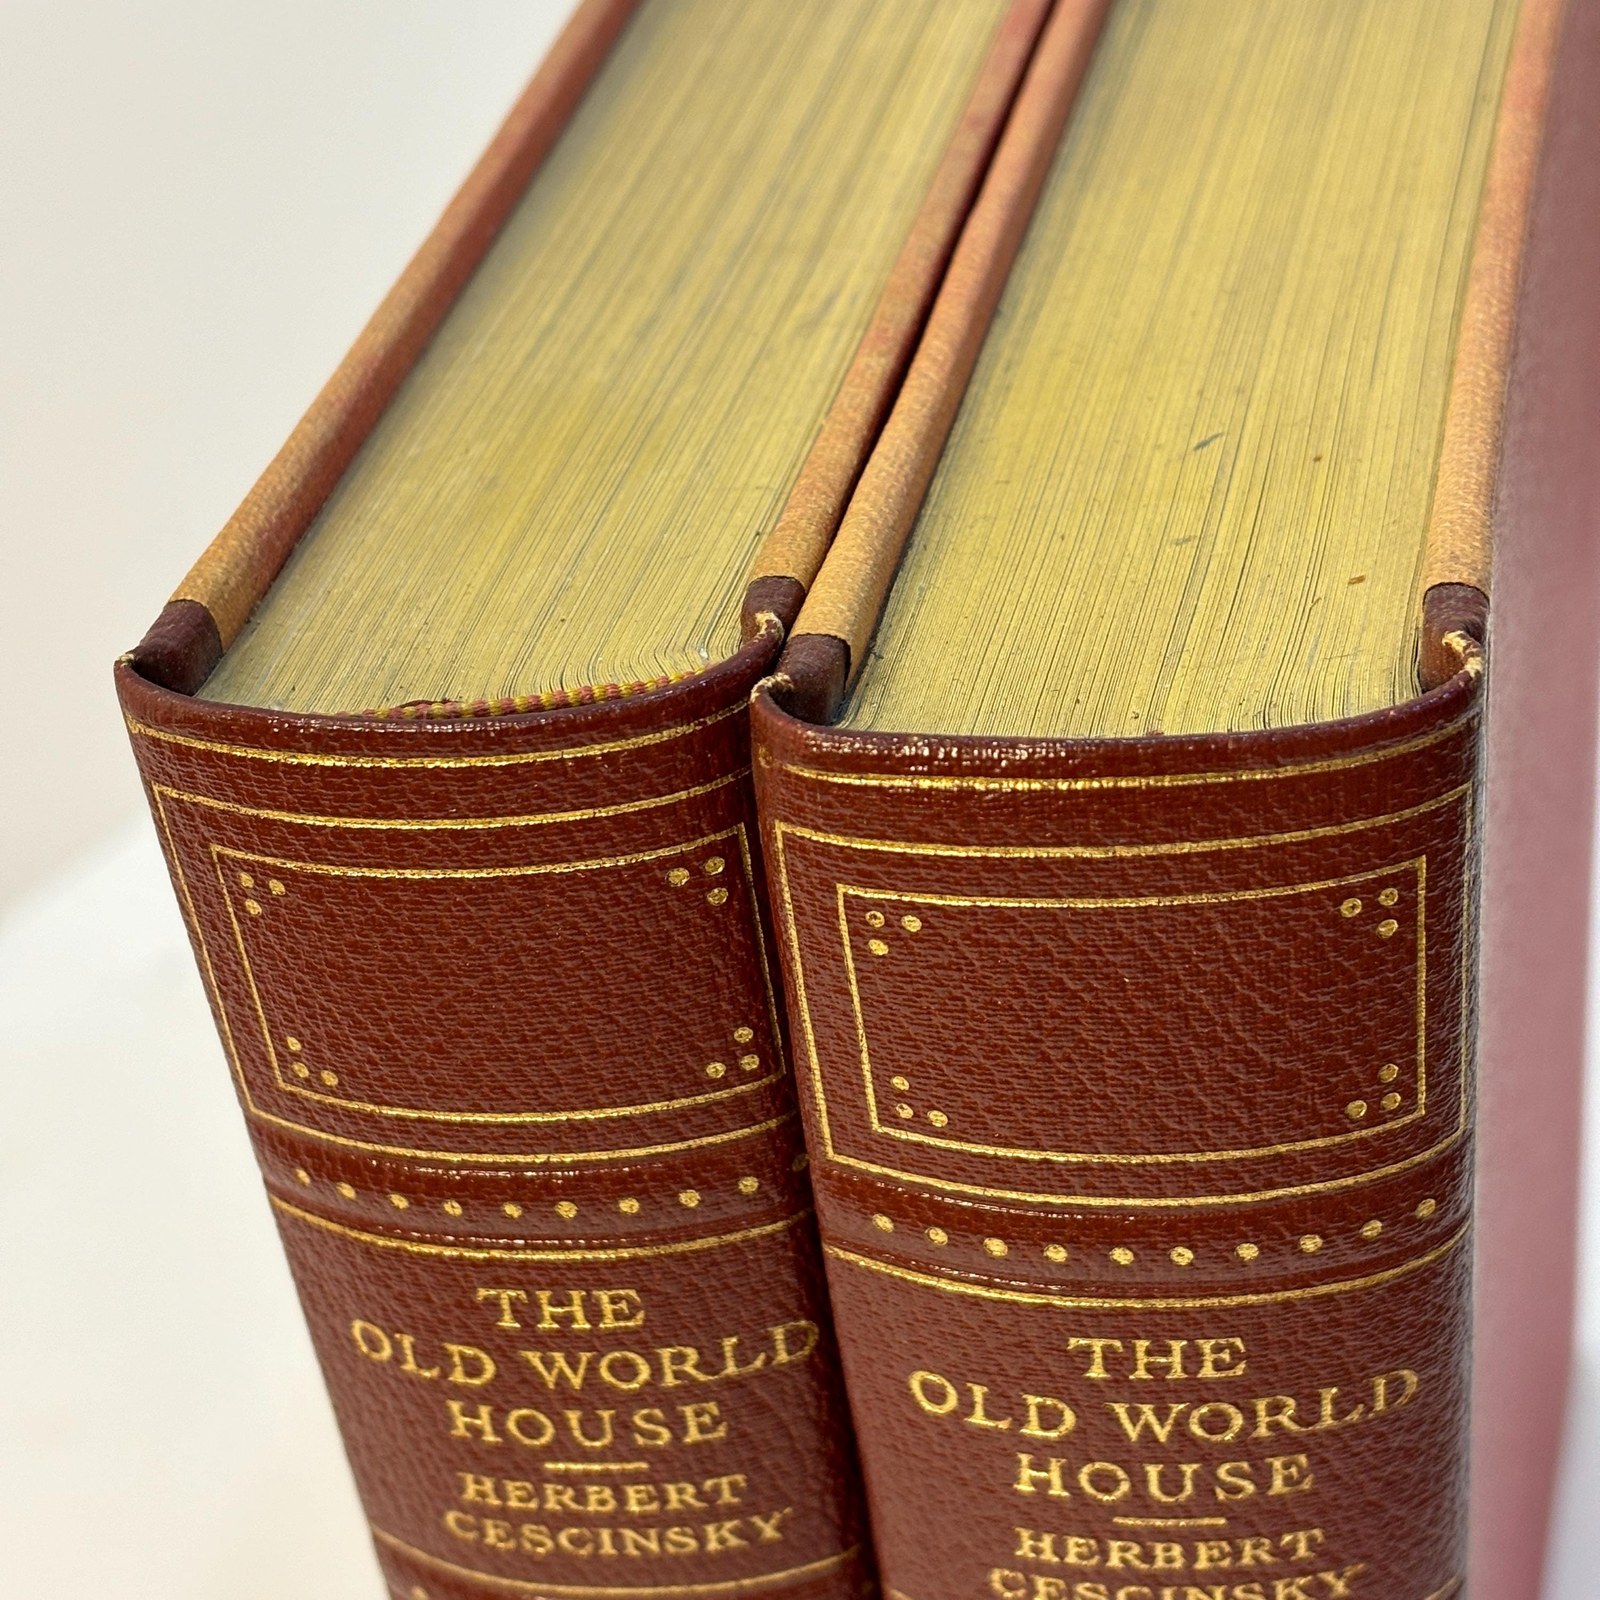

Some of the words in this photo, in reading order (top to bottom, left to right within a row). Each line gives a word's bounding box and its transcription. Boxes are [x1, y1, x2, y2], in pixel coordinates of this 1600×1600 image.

[476, 1287, 645, 1330] THE
[350, 1318, 497, 1387] OLD
[520, 1319, 820, 1390] WORLD
[1066, 1336, 1247, 1380] THE
[445, 1399, 728, 1448] HOUSE
[908, 1370, 1076, 1441] OLD
[1106, 1368, 1420, 1443] WORLD
[457, 1472, 747, 1514] HERBERT
[1012, 1452, 1315, 1503] HOUSE
[442, 1507, 794, 1556] CESCINSKY
[1013, 1526, 1325, 1571] HERBERT
